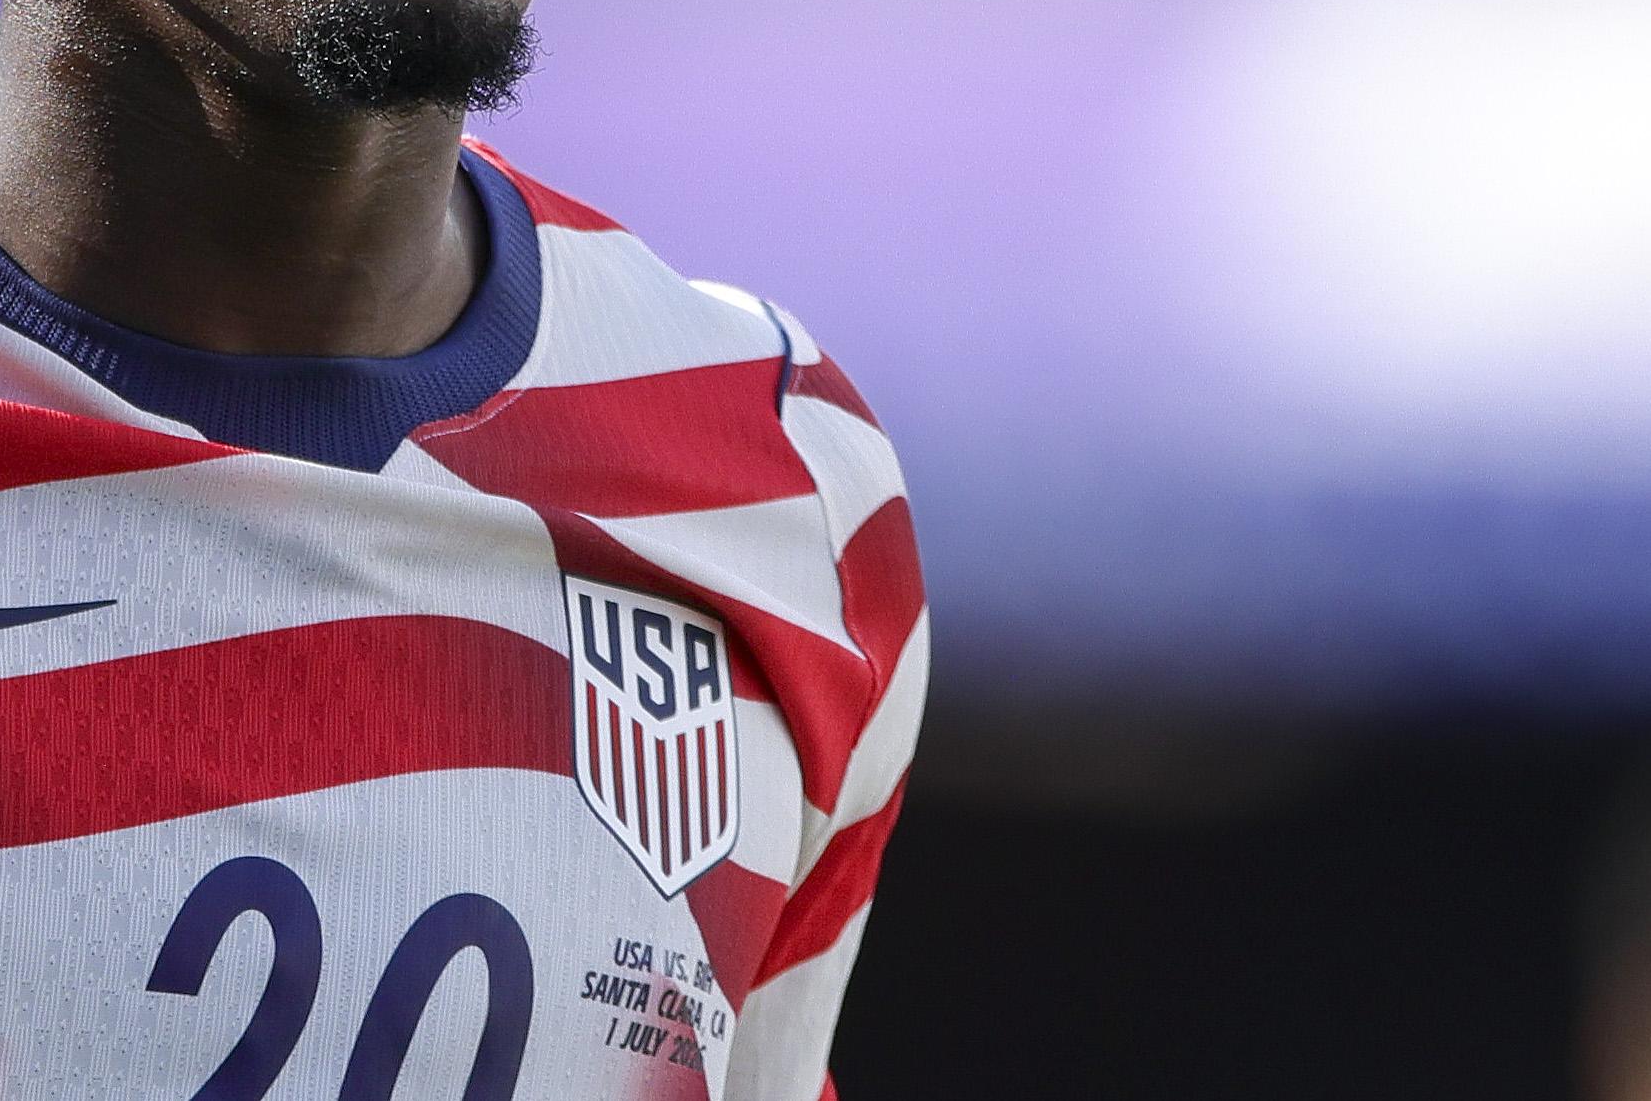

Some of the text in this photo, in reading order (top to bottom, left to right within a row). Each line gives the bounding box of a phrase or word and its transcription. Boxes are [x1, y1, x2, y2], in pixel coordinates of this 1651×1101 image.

[578, 593, 722, 722] USA
[145, 855, 535, 1101] 20
[613, 937, 654, 973] USA
[662, 949, 688, 983] VS.
[581, 971, 651, 1013] SANTA
[605, 1017, 618, 1046] 1
[619, 1020, 670, 1057] JULY
